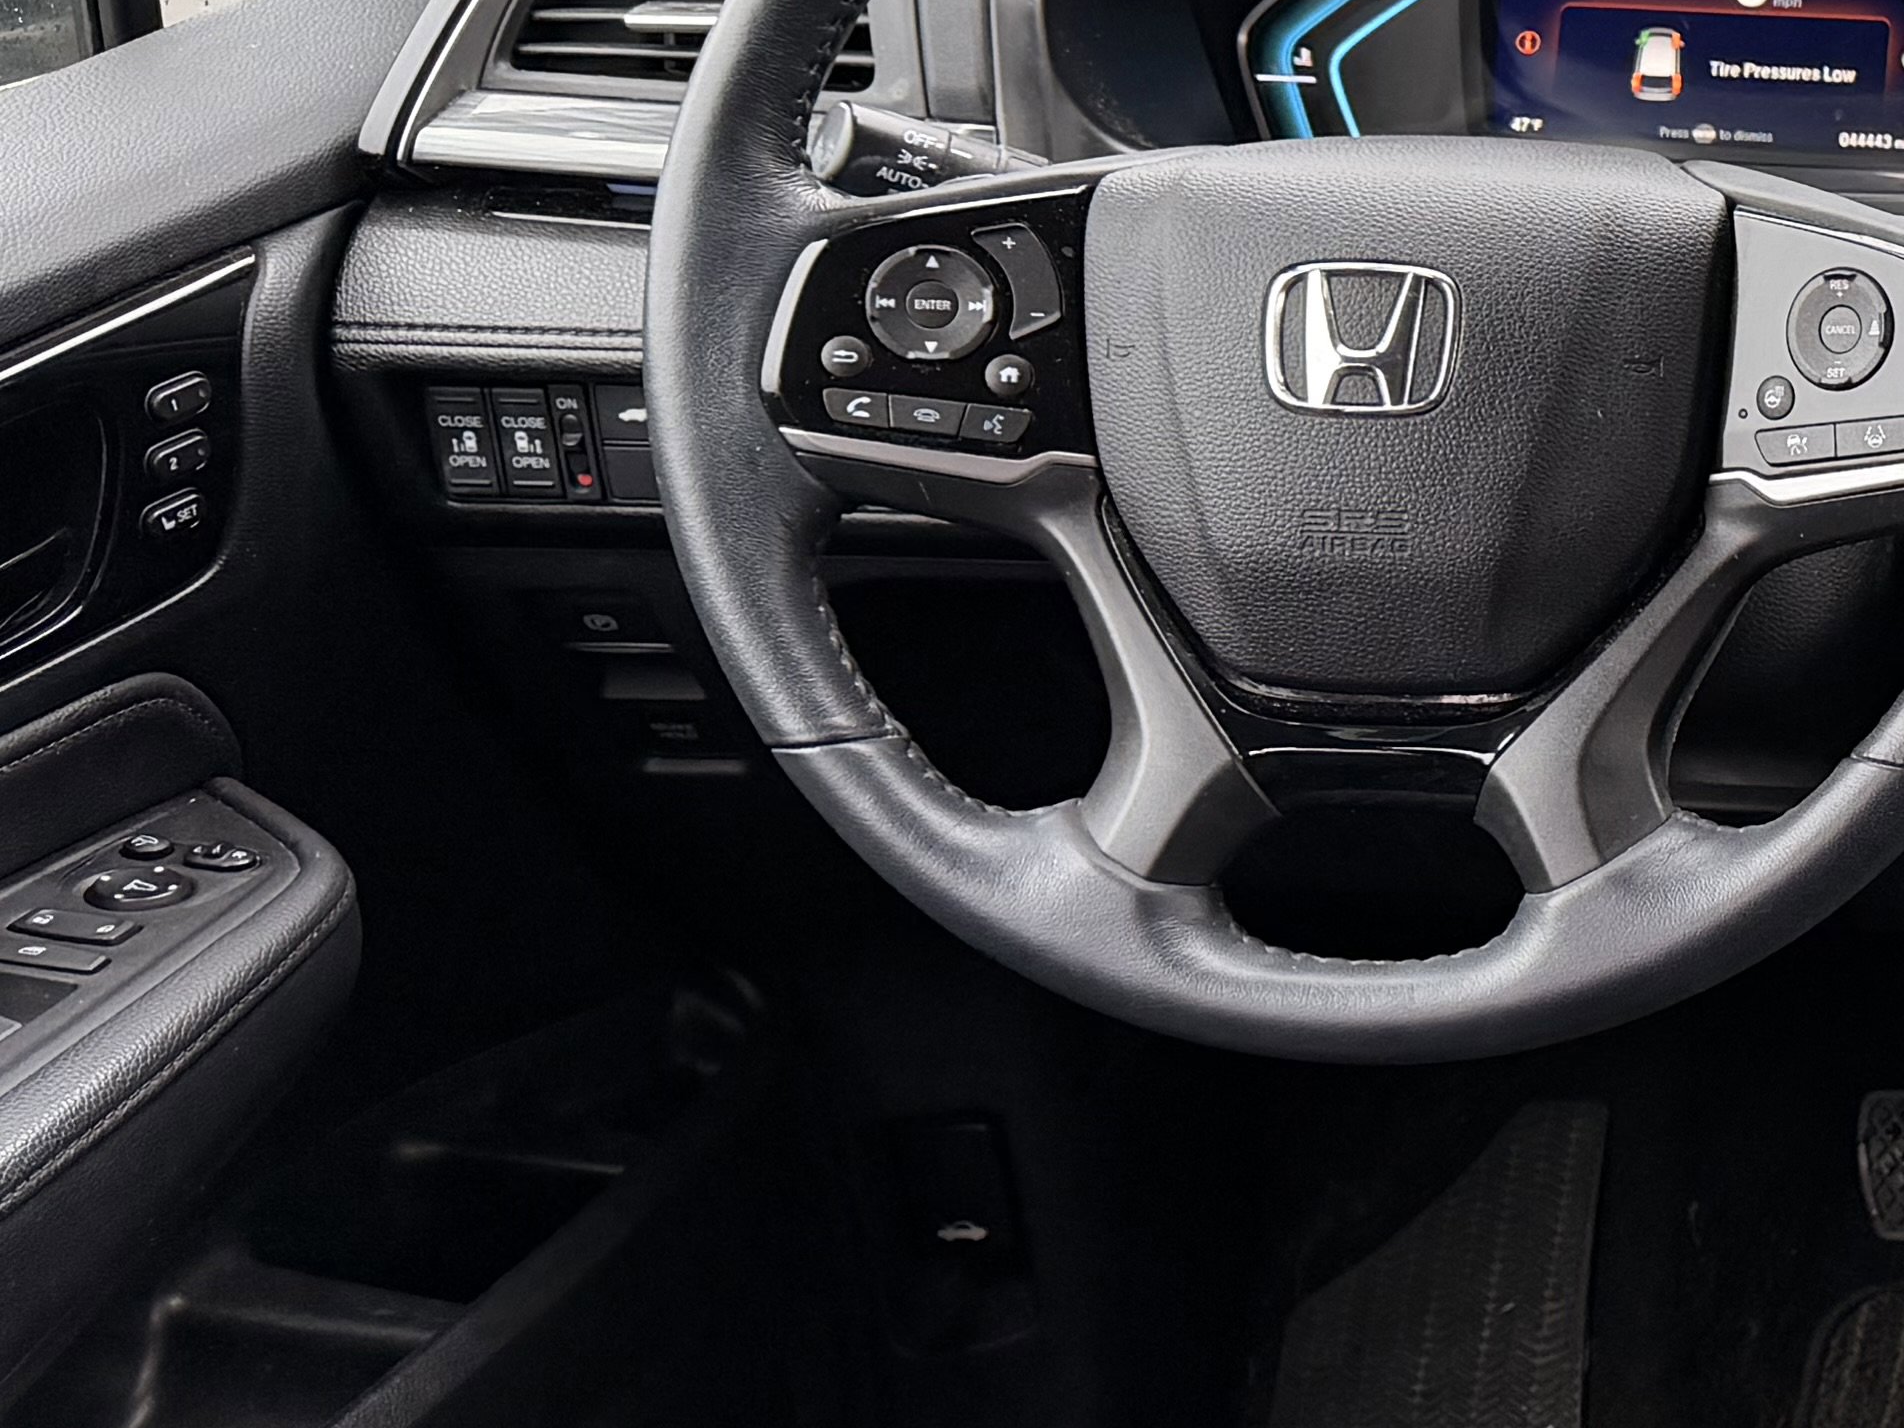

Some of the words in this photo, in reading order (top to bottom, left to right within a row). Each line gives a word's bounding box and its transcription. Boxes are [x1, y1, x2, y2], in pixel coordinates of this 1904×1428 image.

[1709, 60, 1740, 78] Tire
[1743, 62, 1821, 82] Pressures
[1823, 65, 1857, 84] Low
[903, 129, 936, 149] OFF
[1659, 126, 1690, 140] Press
[1719, 128, 1732, 141] to
[1733, 129, 1774, 143] dismiss
[876, 165, 923, 189] AUTO
[1829, 279, 1849, 290] RES
[913, 298, 952, 312] ENTER
[1825, 325, 1856, 335] CANCEL
[1826, 367, 1846, 379] SET
[170, 398, 179, 412] 1
[555, 397, 579, 410] ON
[437, 415, 484, 428] CLOSE
[501, 416, 547, 430] CLOSE
[169, 457, 179, 471] 2
[449, 454, 487, 468] OPEN
[511, 456, 550, 469] OPEN
[176, 503, 198, 523] SET
